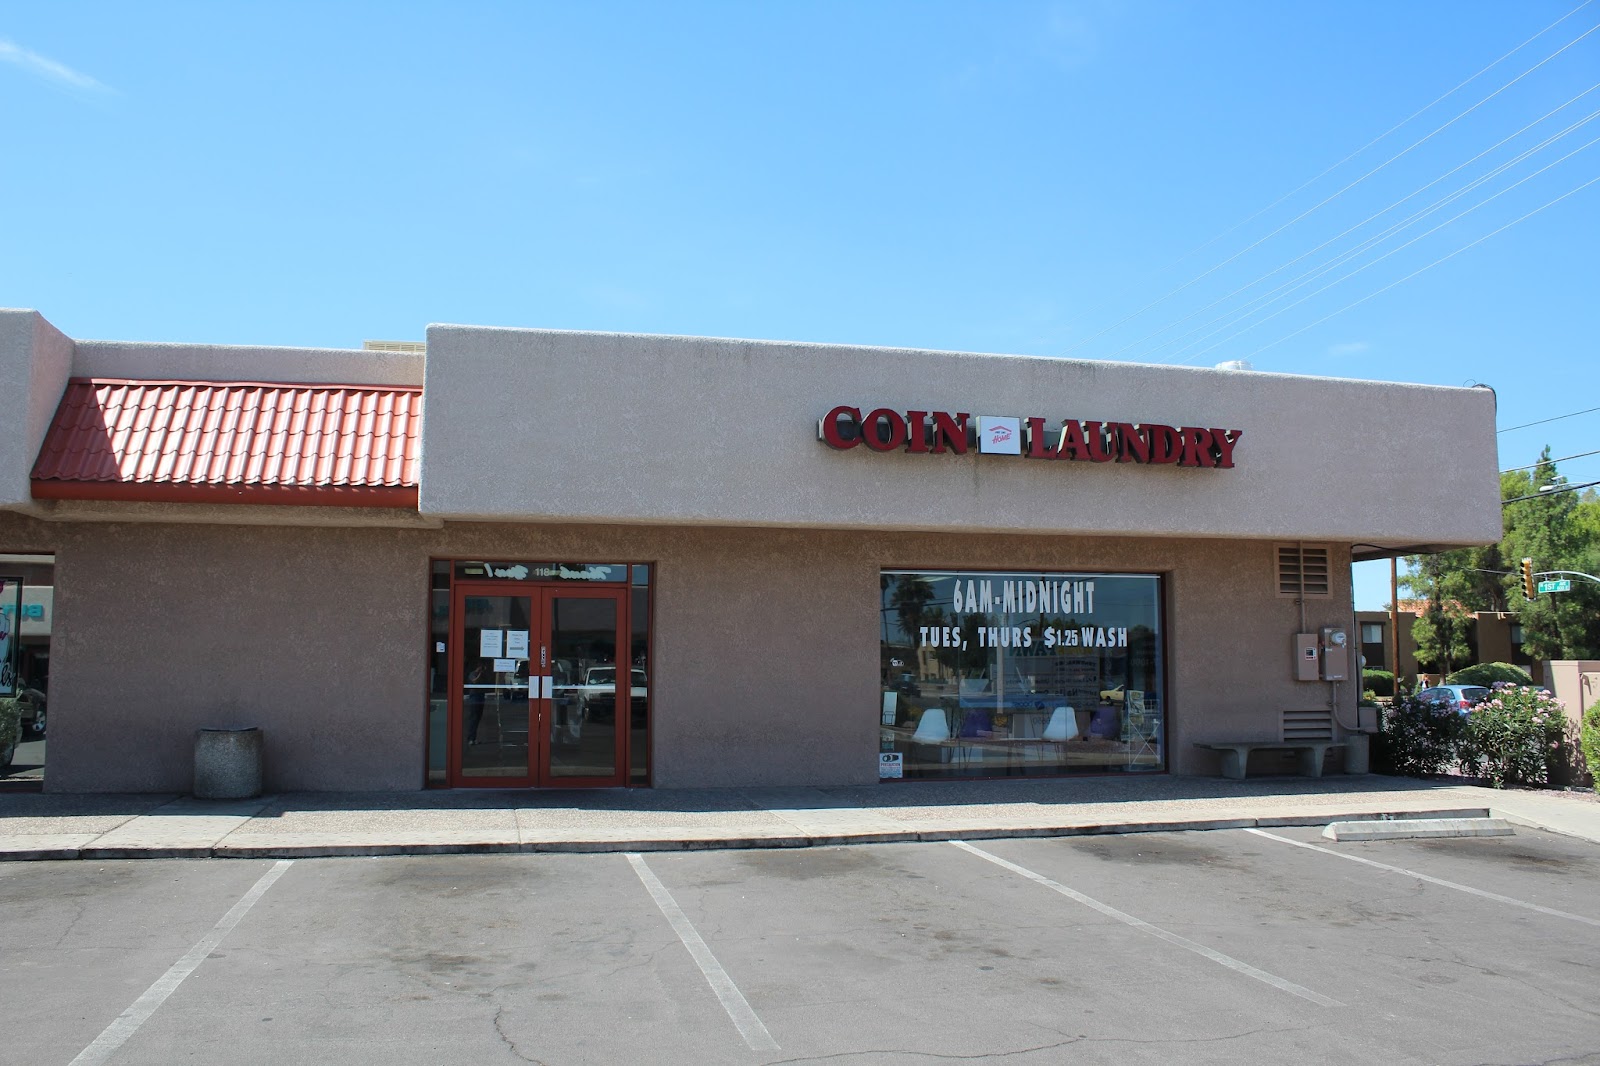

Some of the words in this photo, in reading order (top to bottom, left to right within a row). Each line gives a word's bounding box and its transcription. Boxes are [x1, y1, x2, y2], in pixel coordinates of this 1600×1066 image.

[821, 406, 969, 453] COIN
[1027, 417, 1242, 468] LAUNDRY
[535, 567, 550, 576] 118
[953, 579, 1095, 614] 6AM-MIDNIGHT
[919, 627, 968, 651] TUES,
[977, 626, 1032, 648] THURS
[1044, 626, 1078, 648] $1.25
[1081, 627, 1128, 648] WASH
